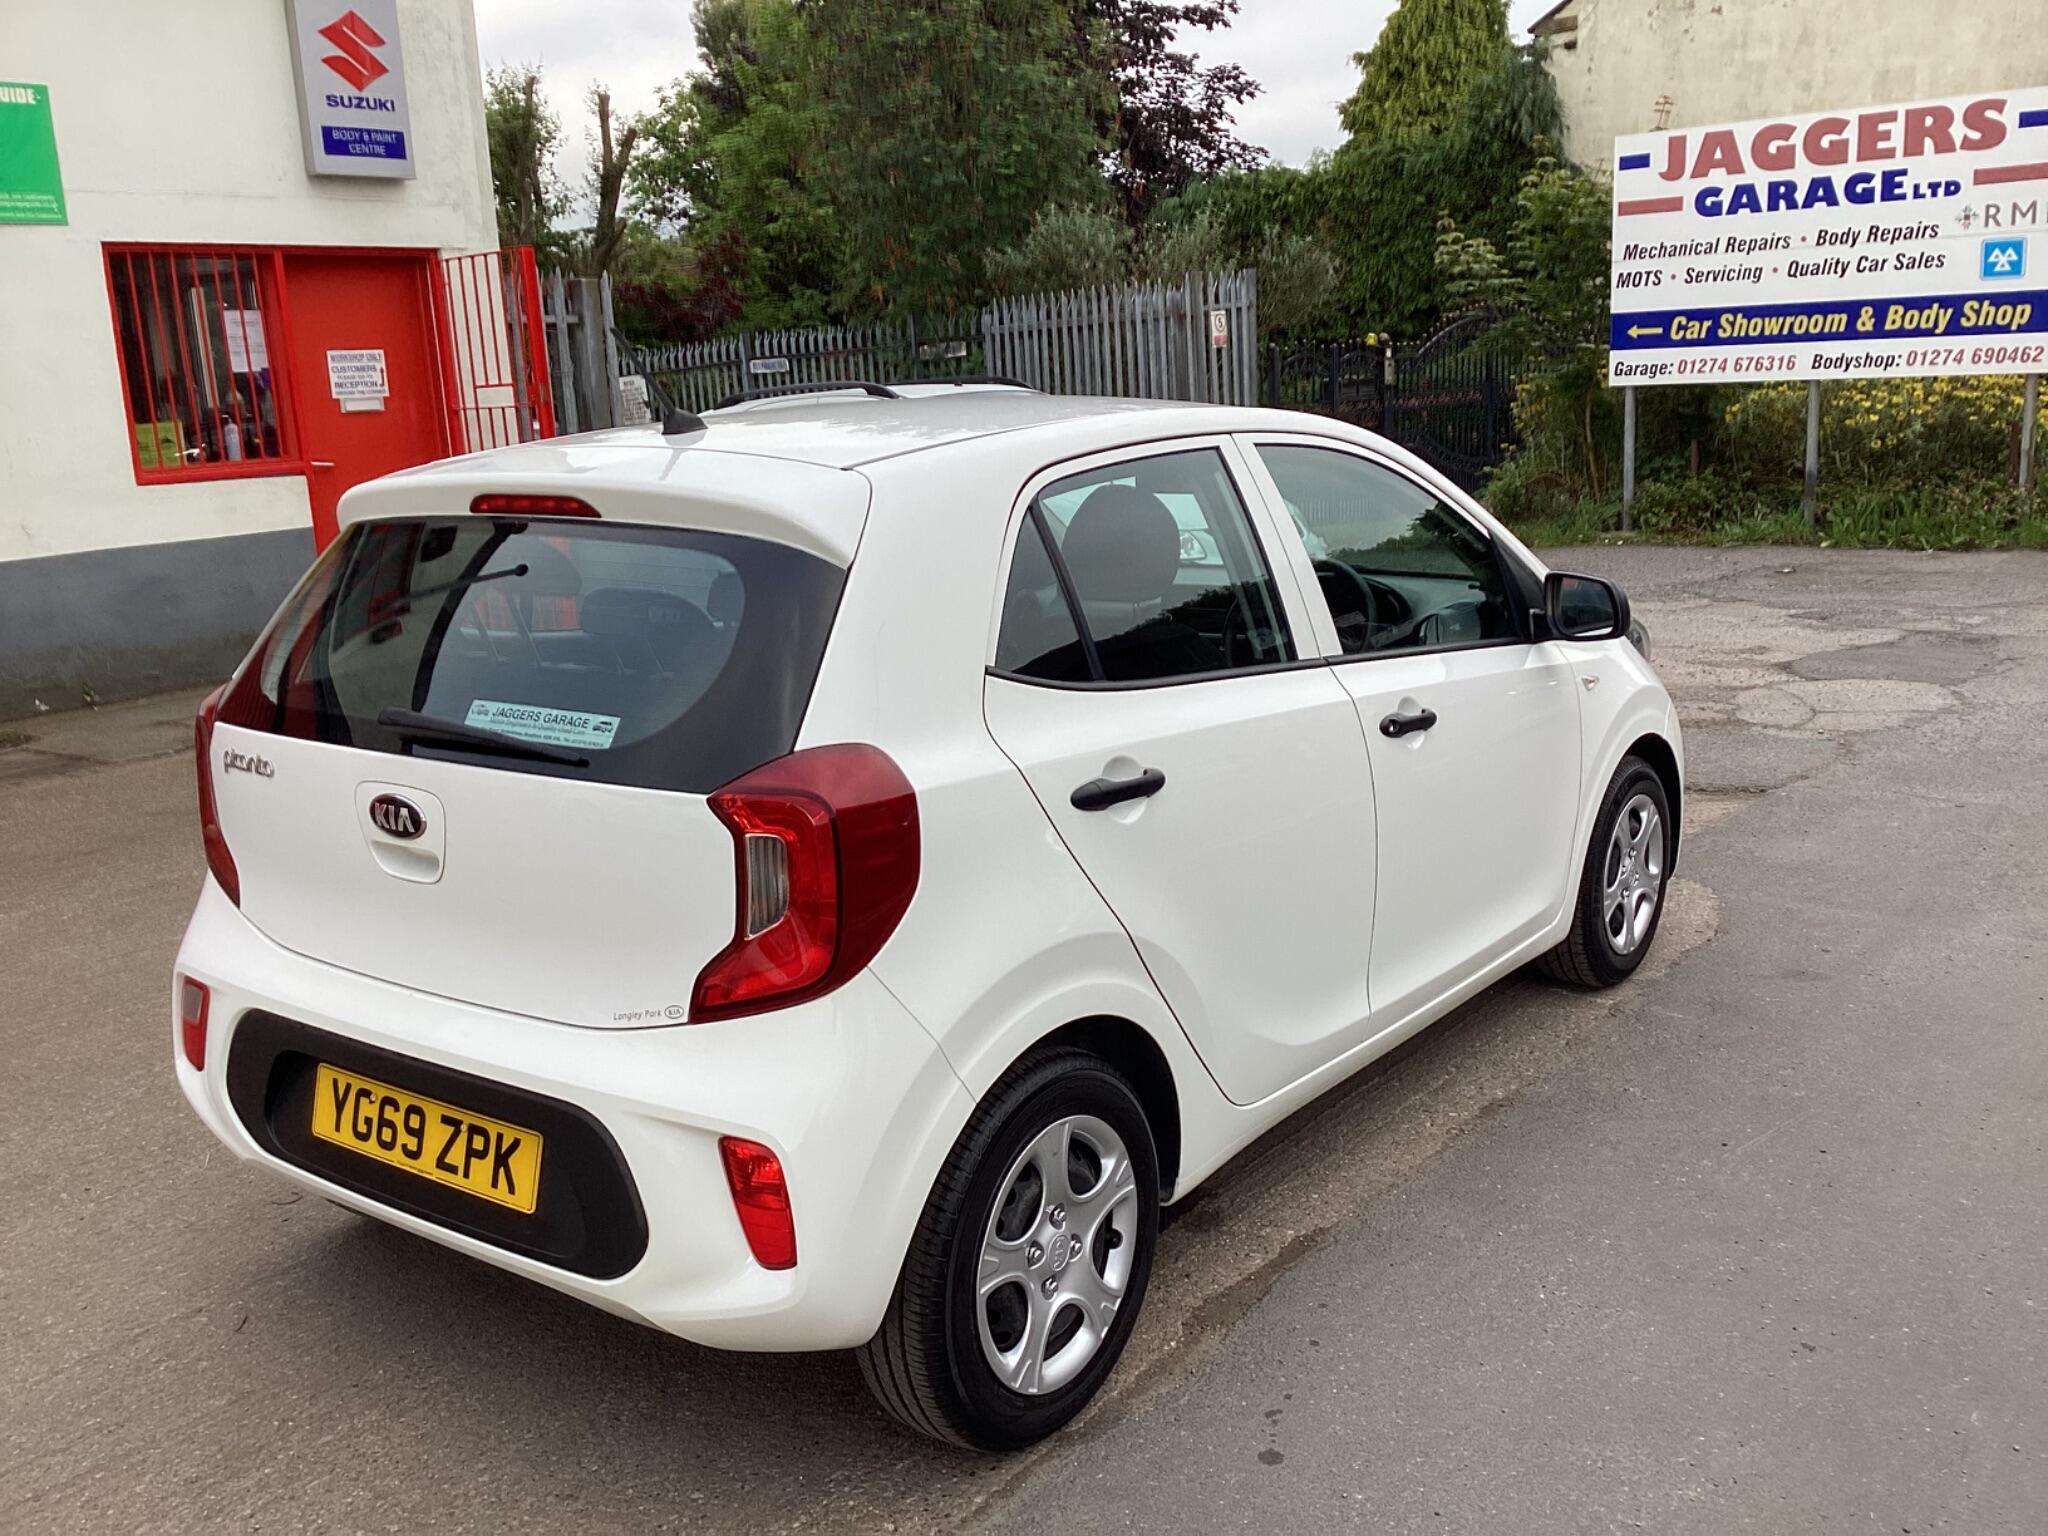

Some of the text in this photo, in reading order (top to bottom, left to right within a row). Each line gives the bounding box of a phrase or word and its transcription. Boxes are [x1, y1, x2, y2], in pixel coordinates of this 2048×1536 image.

[325, 94, 396, 112] SUZUKI
[332, 129, 397, 144] BODY & PAINT
[349, 143, 387, 155] CENTRE
[1658, 99, 2008, 182] JAGGERS
[1694, 168, 1961, 217] GARAGE LTD
[1623, 222, 1939, 261] Mechanical Repairs Body Repairs
[1616, 251, 1946, 289] MOTS Servicing Quality Car Sales
[1669, 299, 2032, 341] Car Showroom & Body Shop
[331, 365, 377, 374] CUSTOMERS
[1614, 345, 2044, 379] Garage: 01274 676316 Bodyshop: 01274 690462
[334, 381, 378, 389] RECEPTION
[492, 706, 590, 729] JAGGERS GARAGE
[374, 802, 415, 833] KIA
[613, 1012, 642, 1022] Langley
[645, 1009, 661, 1017] Park
[332, 1077, 522, 1196] YG69 ZPK
